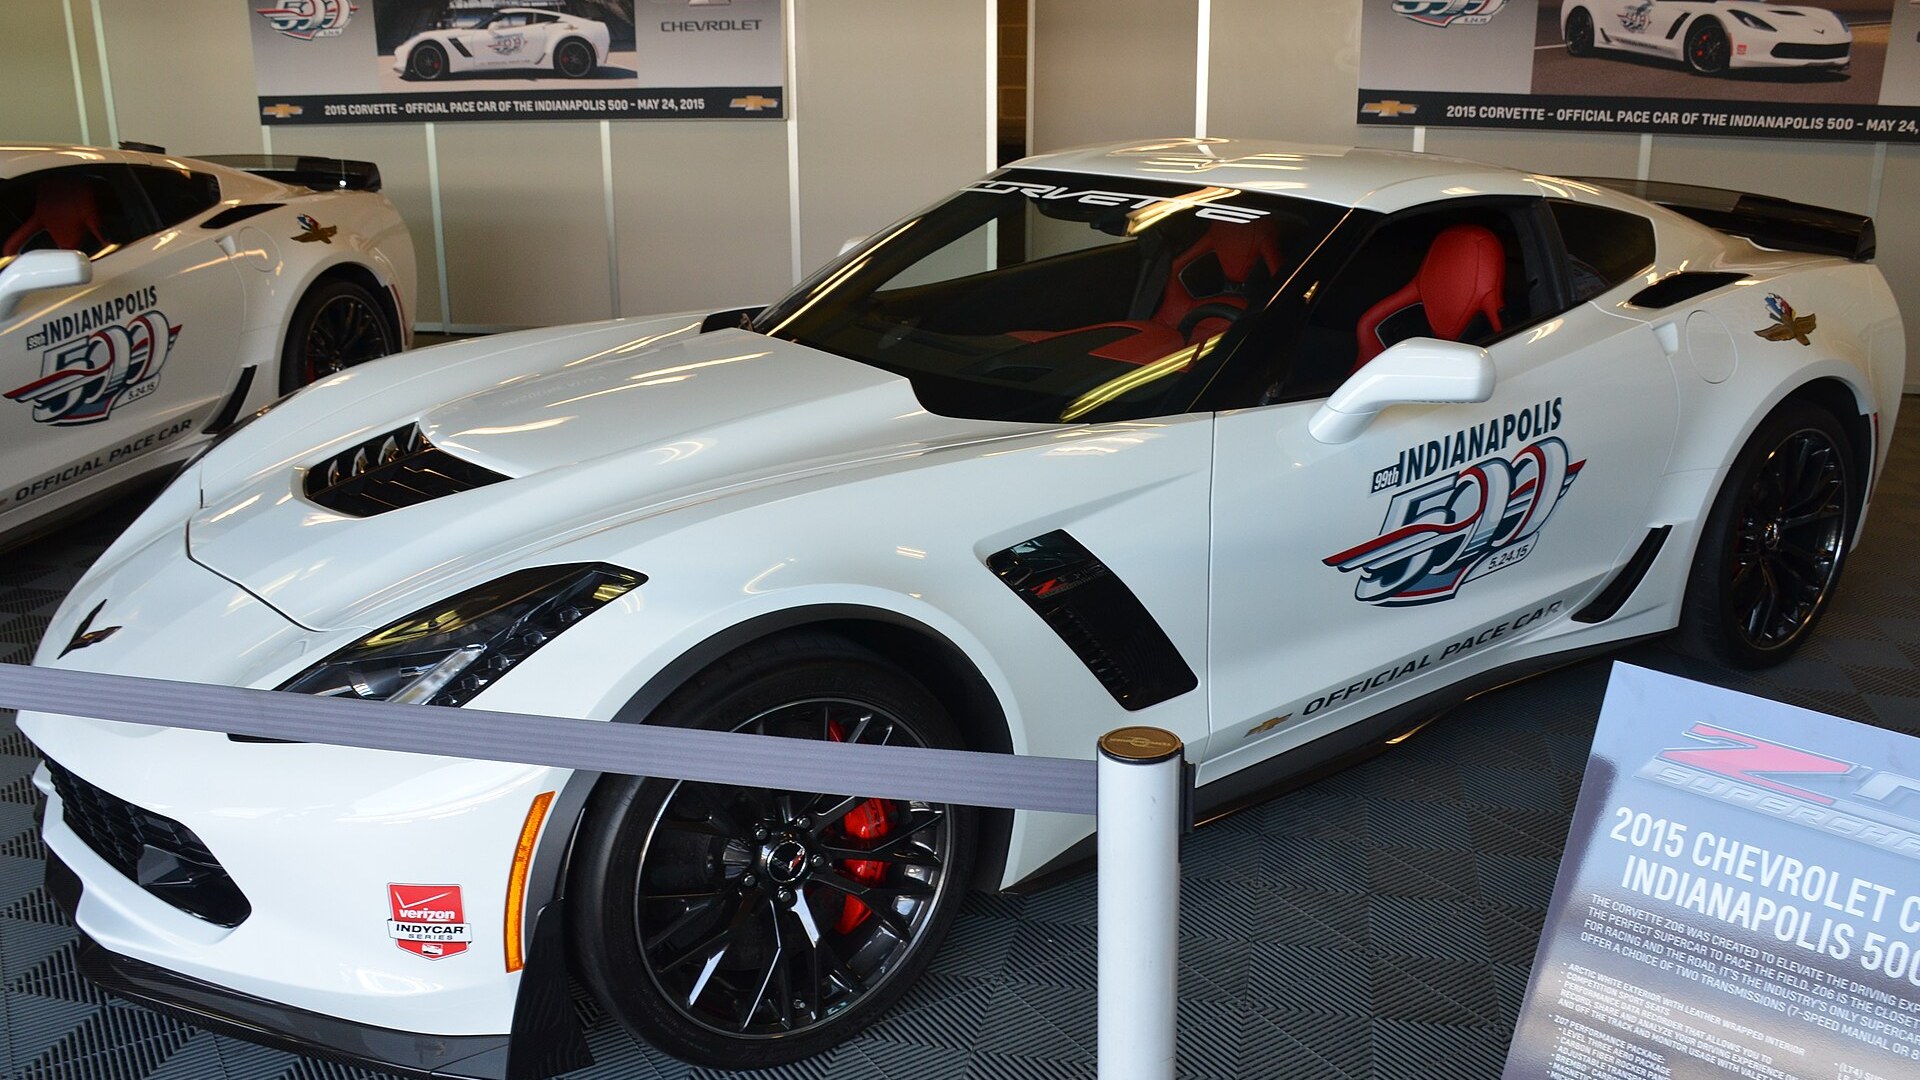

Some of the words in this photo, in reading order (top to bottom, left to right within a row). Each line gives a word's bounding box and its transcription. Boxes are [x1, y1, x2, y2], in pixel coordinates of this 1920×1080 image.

[660, 19, 763, 32] CHEVROLET
[324, 105, 347, 116] 2015
[348, 103, 398, 115] CORVETTE
[405, 102, 449, 114] OFFICIAL
[450, 101, 475, 113] PACE
[476, 101, 498, 113] CAR
[498, 101, 512, 112] OF
[513, 101, 534, 112] THE
[535, 99, 606, 112] INDIANAPOLIS
[608, 99, 629, 111] 500
[637, 99, 660, 110] MAY
[661, 98, 679, 111] 24,
[680, 98, 705, 110] 2015
[1446, 105, 1476, 118] 2015
[1479, 106, 1545, 121] CORVETTE
[1556, 108, 1614, 123] OFFICIAL
[1616, 110, 1650, 123] PACE
[1652, 111, 1679, 124] CAR
[1681, 112, 1699, 125] OF
[1702, 113, 1727, 127] THE
[1729, 114, 1825, 130] INDIANAPOLIS
[1826, 117, 1854, 131] 500
[1865, 119, 1900, 132] MAY
[1897, 119, 1919, 135] 24,
[43, 285, 158, 346] INDIANAPOLIS
[32, 310, 170, 423] 500
[15, 457, 103, 501] OFFICIAL
[109, 434, 154, 463] PACE
[158, 419, 192, 441] CAR
[1374, 464, 1400, 491] 99th
[1397, 397, 1562, 488] INDIANAPOLIS
[1355, 437, 1569, 602] 500
[1488, 544, 1529, 570] 5.24.15
[1302, 655, 1431, 716] OFFICIAL
[1440, 621, 1509, 661] PACE
[1511, 600, 1563, 630] CAR
[1610, 806, 1688, 858] 2015
[1691, 832, 1896, 923] CHEVROLET
[396, 923, 464, 934] INDYCAR
[398, 907, 456, 922] verizon
[1621, 854, 1855, 960] INDIANAPOLIS
[1583, 919, 1604, 933] FOR
[1605, 926, 1641, 946] RACING
[1642, 939, 1664, 954] AND
[1664, 947, 1686, 962] THE
[1687, 955, 1718, 973] ROAD.
[1718, 966, 1739, 980] IT'S
[1740, 974, 1762, 989] THE
[1763, 982, 1827, 1011] INDUSTRY'S
[1829, 1004, 1859, 1023] ONLY
[1587, 906, 1607, 920] THE
[1608, 914, 1652, 936] PERFECT
[1654, 929, 1708, 955] SUPERCAR
[1710, 949, 1723, 960] TO
[1724, 954, 1752, 970] PACE
[1753, 964, 1775, 978] THE
[1776, 972, 1810, 991] FIELD.
[1812, 984, 1835, 999] Z06
[1836, 992, 1848, 1004] IS
[1850, 997, 1873, 1012] THE
[1590, 893, 1611, 907] THE
[1611, 900, 1663, 925] CORVETTE
[1664, 918, 1685, 932] Z06
[1686, 926, 1711, 941] WAS
[1711, 935, 1759, 958] CREATED
[1762, 952, 1775, 964] TO
[1776, 957, 1824, 980] ELEVATE
[1825, 974, 1848, 989] THE
[1850, 982, 1897, 1005] DRIVING
[1564, 981, 1620, 1007] PERFORMANCE
[1620, 1002, 1640, 1014] DATA
[1641, 1009, 1683, 1030] RECORDER
[1684, 1026, 1706, 1039] THAT
[1706, 1034, 1741, 1052] ALLOWS
[1742, 1047, 1760, 1059] YOU
[1761, 1055, 1772, 1064] TO
[1566, 972, 1617, 996] COMPETITION
[1618, 991, 1644, 1005] SPORT
[1645, 1001, 1670, 1015] SEATS
[1568, 963, 1596, 978] ARCTIC
[1596, 974, 1623, 988] WHITE
[1623, 983, 1661, 1002] EXTERIOR
[1662, 997, 1683, 1010] WITH
[1684, 1006, 1721, 1024] LEATHER
[1722, 1019, 1764, 1040] WRAPPED
[1765, 1035, 1806, 1055] INTERIOR
[1580, 932, 1612, 950] OFFER
[1612, 943, 1622, 953] A
[1621, 946, 1658, 966] CHOICE
[1659, 960, 1674, 972] OF
[1674, 965, 1699, 981] TWO
[1700, 974, 1786, 1012] TRANSMISSIONS
[1787, 1005, 1840, 1031] (7-SPEED
[1841, 1024, 1891, 1049] MANUAL
[1892, 1042, 1911, 1056] OR
[1557, 1045, 1606, 1069] ADJUSTABLE
[1558, 998, 1574, 1009] AND
[1575, 1004, 1590, 1015] OFF
[1590, 1010, 1607, 1021] THE
[1607, 1016, 1634, 1031] TRACK
[1633, 1026, 1651, 1038] AND
[1651, 1033, 1688, 1052] MONITOR
[1688, 1047, 1716, 1063] USAGE
[1717, 1058, 1740, 1072] WITH
[1560, 1036, 1591, 1054] CARBON
[1592, 1049, 1615, 1063] FIBER
[1615, 1058, 1647, 1075] ROCKER
[1562, 1028, 1586, 1042] LEVEL
[1587, 1037, 1612, 1052] THREE
[1613, 1048, 1634, 1061] AERO
[1634, 1056, 1671, 1075] PACKAGE
[1569, 1021, 1626, 1048] PERFORMANCE
[1593, 1001, 1620, 1017] SHARE
[1620, 1011, 1638, 1023] AND
[1638, 1018, 1673, 1037] ANALYZE
[1674, 1032, 1696, 1045] YOUR
[1697, 1040, 1731, 1059] DRIVING
[1731, 1053, 1784, 1078] EXPERIENCE
